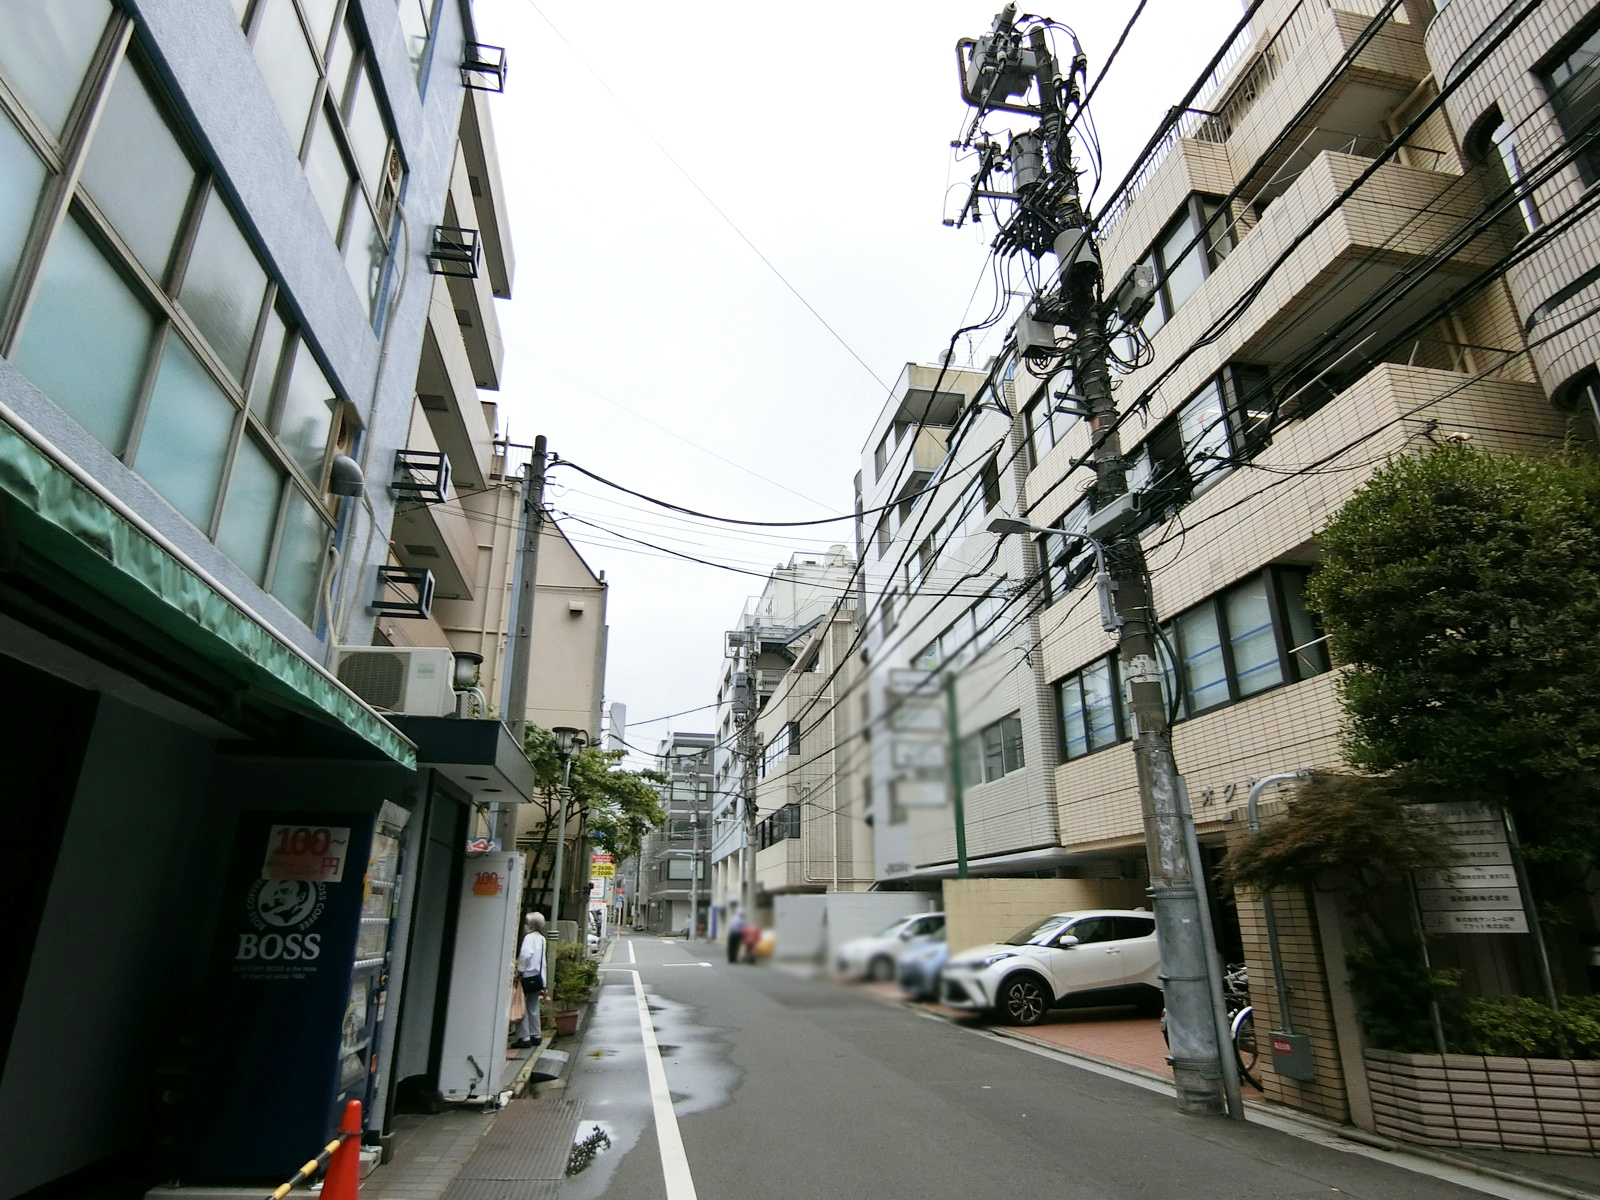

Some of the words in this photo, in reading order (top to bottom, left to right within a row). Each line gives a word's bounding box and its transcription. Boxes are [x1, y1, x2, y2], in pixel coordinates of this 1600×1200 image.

[320, 856, 340, 875] 円
[298, 902, 325, 932] COFFEE
[235, 933, 321, 961] BOSS
